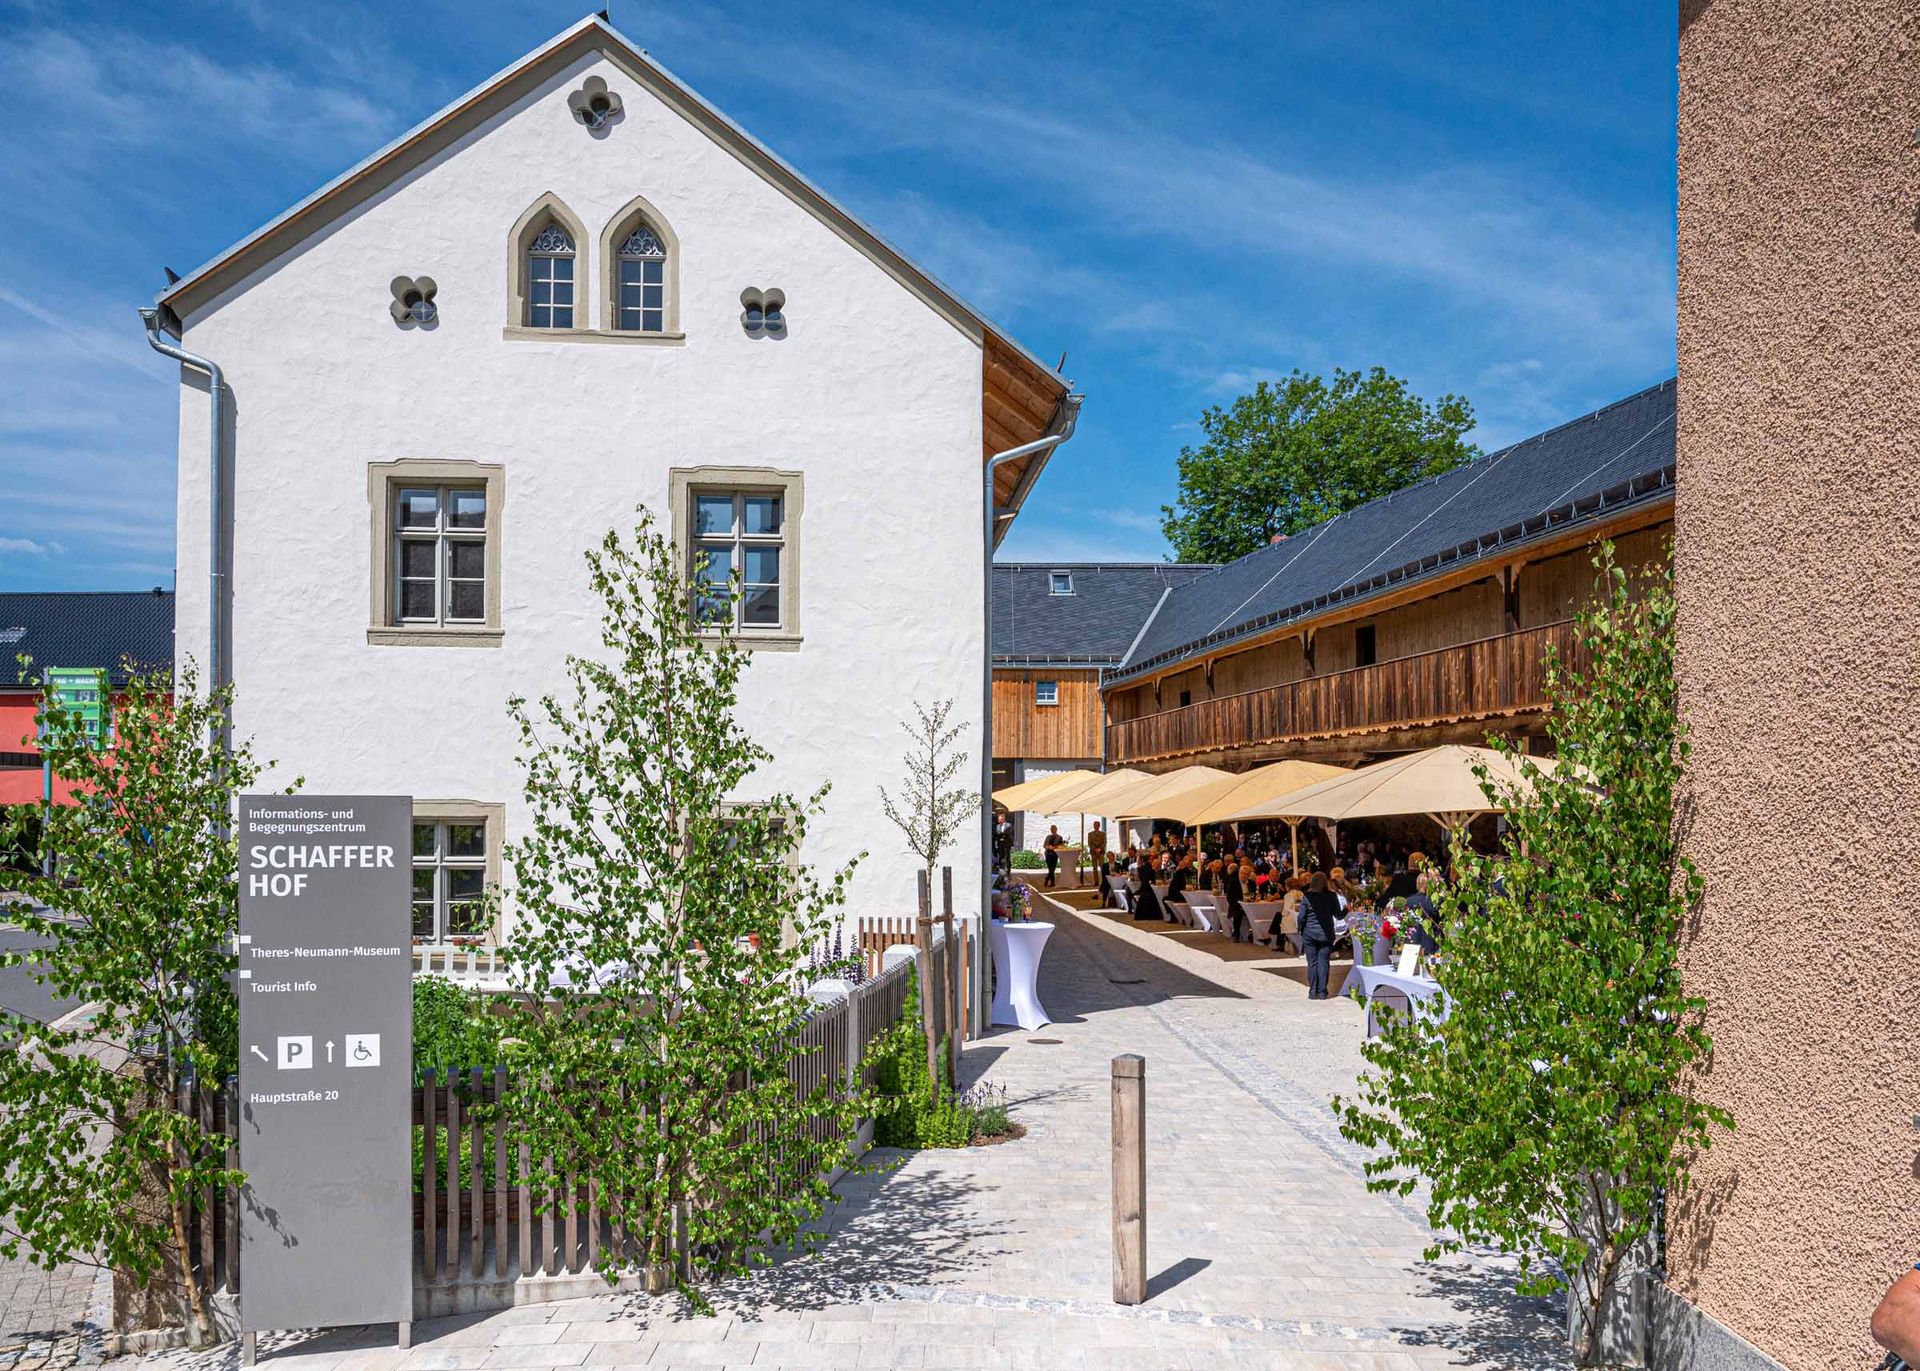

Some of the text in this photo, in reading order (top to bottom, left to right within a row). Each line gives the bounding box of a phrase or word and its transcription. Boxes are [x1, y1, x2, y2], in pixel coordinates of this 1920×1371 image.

[249, 807, 354, 819] Informations- und
[249, 822, 366, 834] Begegnungszentrum
[249, 845, 395, 869] SCHAFFER
[249, 873, 308, 897] HOF
[250, 946, 401, 958] Theres-Neumann-Museum
[250, 980, 317, 993] Tourist Info
[286, 1042, 303, 1063] P
[250, 1090, 339, 1105] Hauptstraße 20
